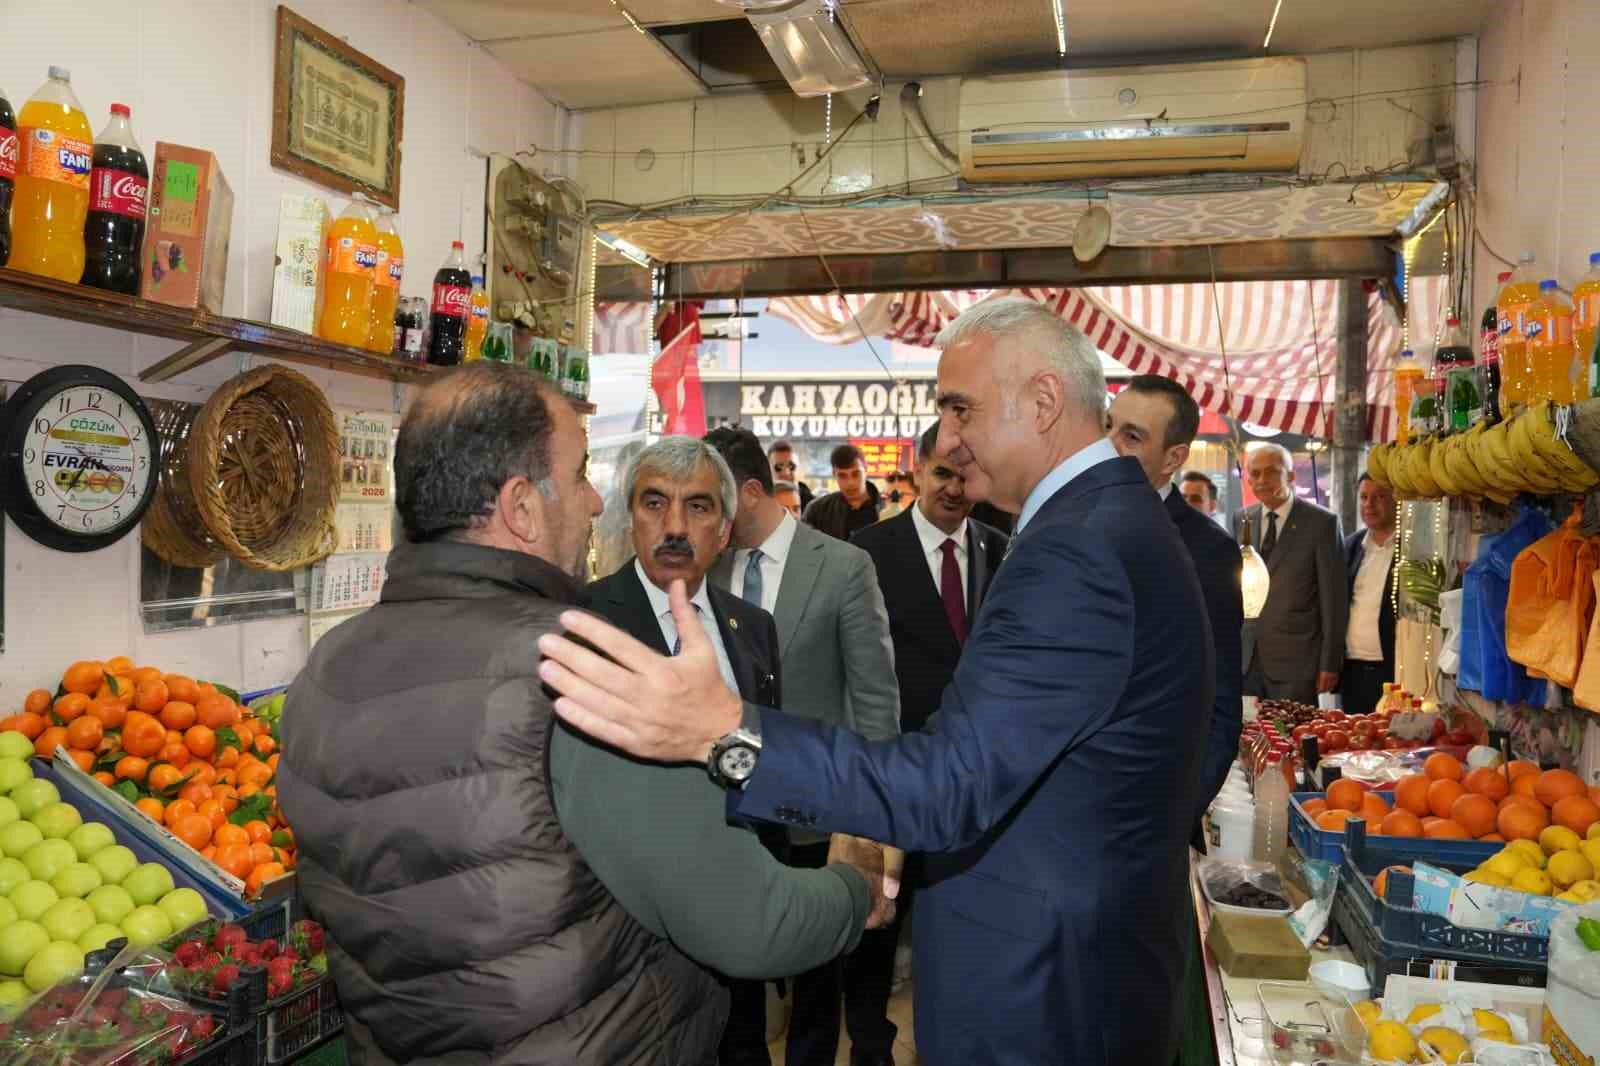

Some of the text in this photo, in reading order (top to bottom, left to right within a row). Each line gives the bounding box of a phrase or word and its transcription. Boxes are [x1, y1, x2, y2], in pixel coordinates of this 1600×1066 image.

[60, 397, 71, 413] 11
[87, 391, 103, 409] 12
[741, 379, 938, 415] KAHYAOĞL
[117, 403, 122, 417] 1
[34, 417, 51, 435] 10
[70, 418, 115, 432] ÇÖZÜM
[131, 425, 141, 441] 2
[24, 448, 35, 464] 9
[45, 454, 105, 470] EVRAN
[35, 479, 46, 496] 8
[128, 485, 137, 499] 4
[57, 504, 66, 521] 7
[82, 512, 93, 528] 6
[113, 505, 121, 521] 5
